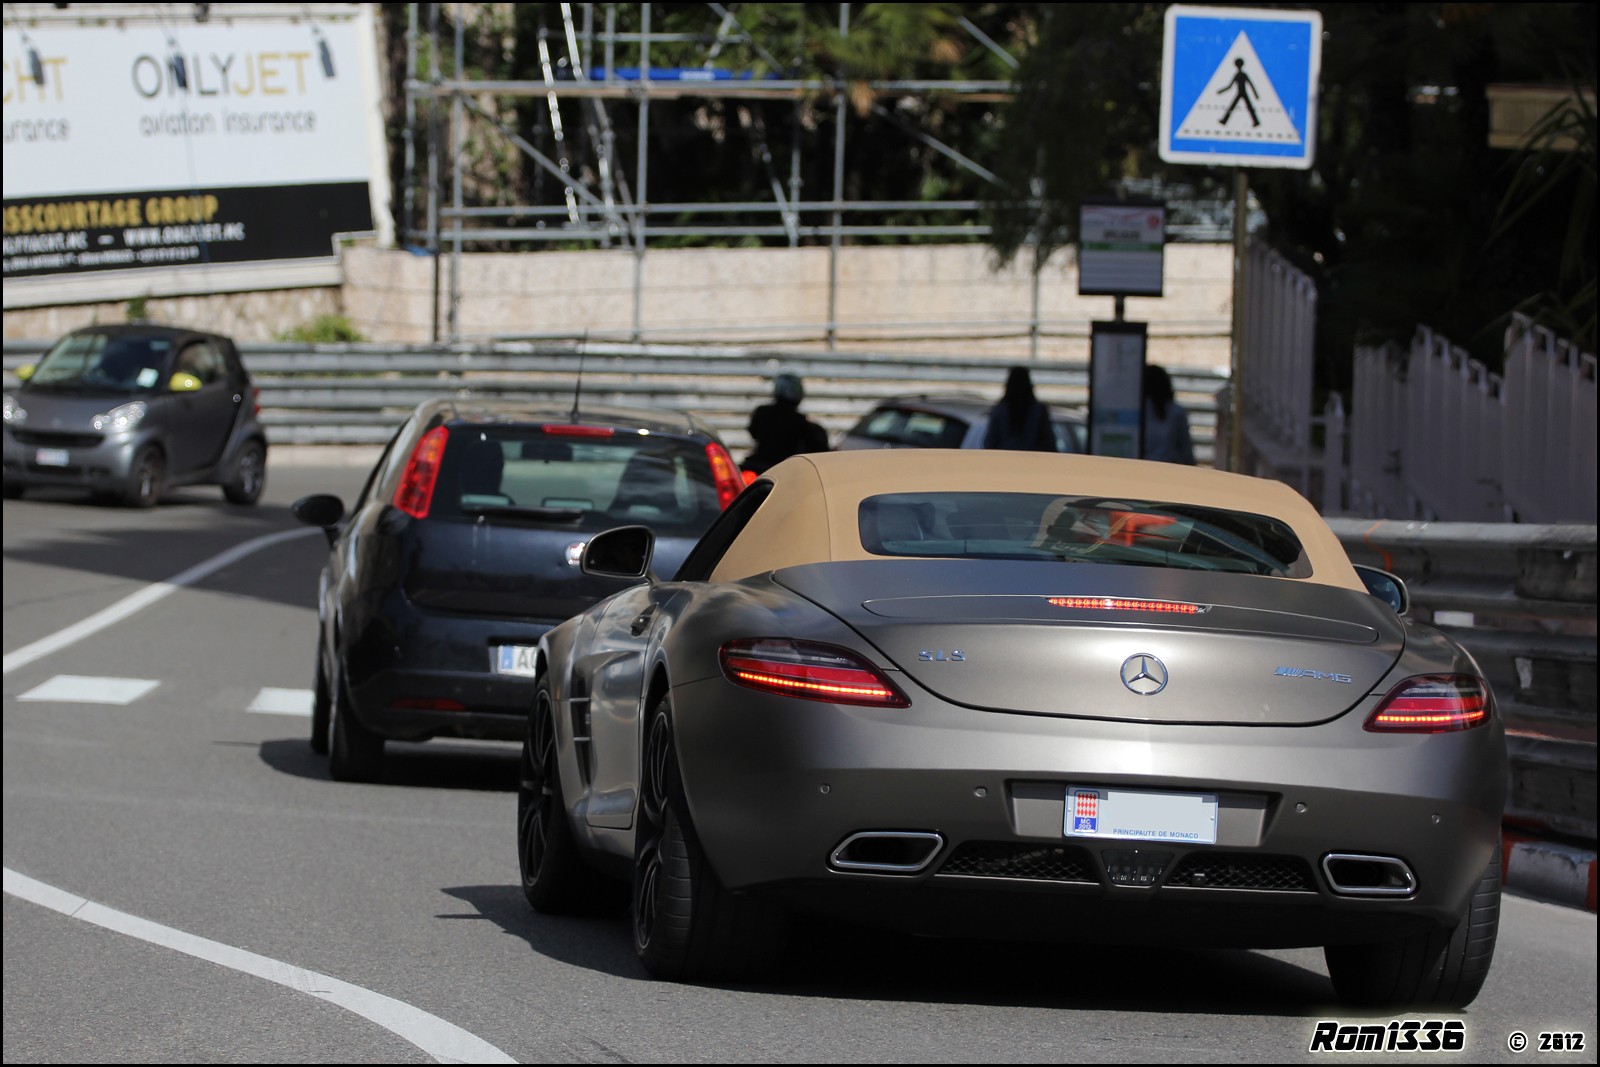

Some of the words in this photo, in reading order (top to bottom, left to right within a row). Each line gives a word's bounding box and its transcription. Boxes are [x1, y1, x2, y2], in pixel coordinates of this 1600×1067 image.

[132, 52, 312, 99] ONLYJET
[140, 110, 216, 136] aviation
[224, 108, 318, 134] insurance
[3, 197, 142, 236] SSCOURTAGE
[145, 194, 219, 226] GROUP
[919, 648, 966, 662] SLS
[1112, 828, 1156, 837] PRINCIPAUTE
[1169, 831, 1199, 839] MONACO
